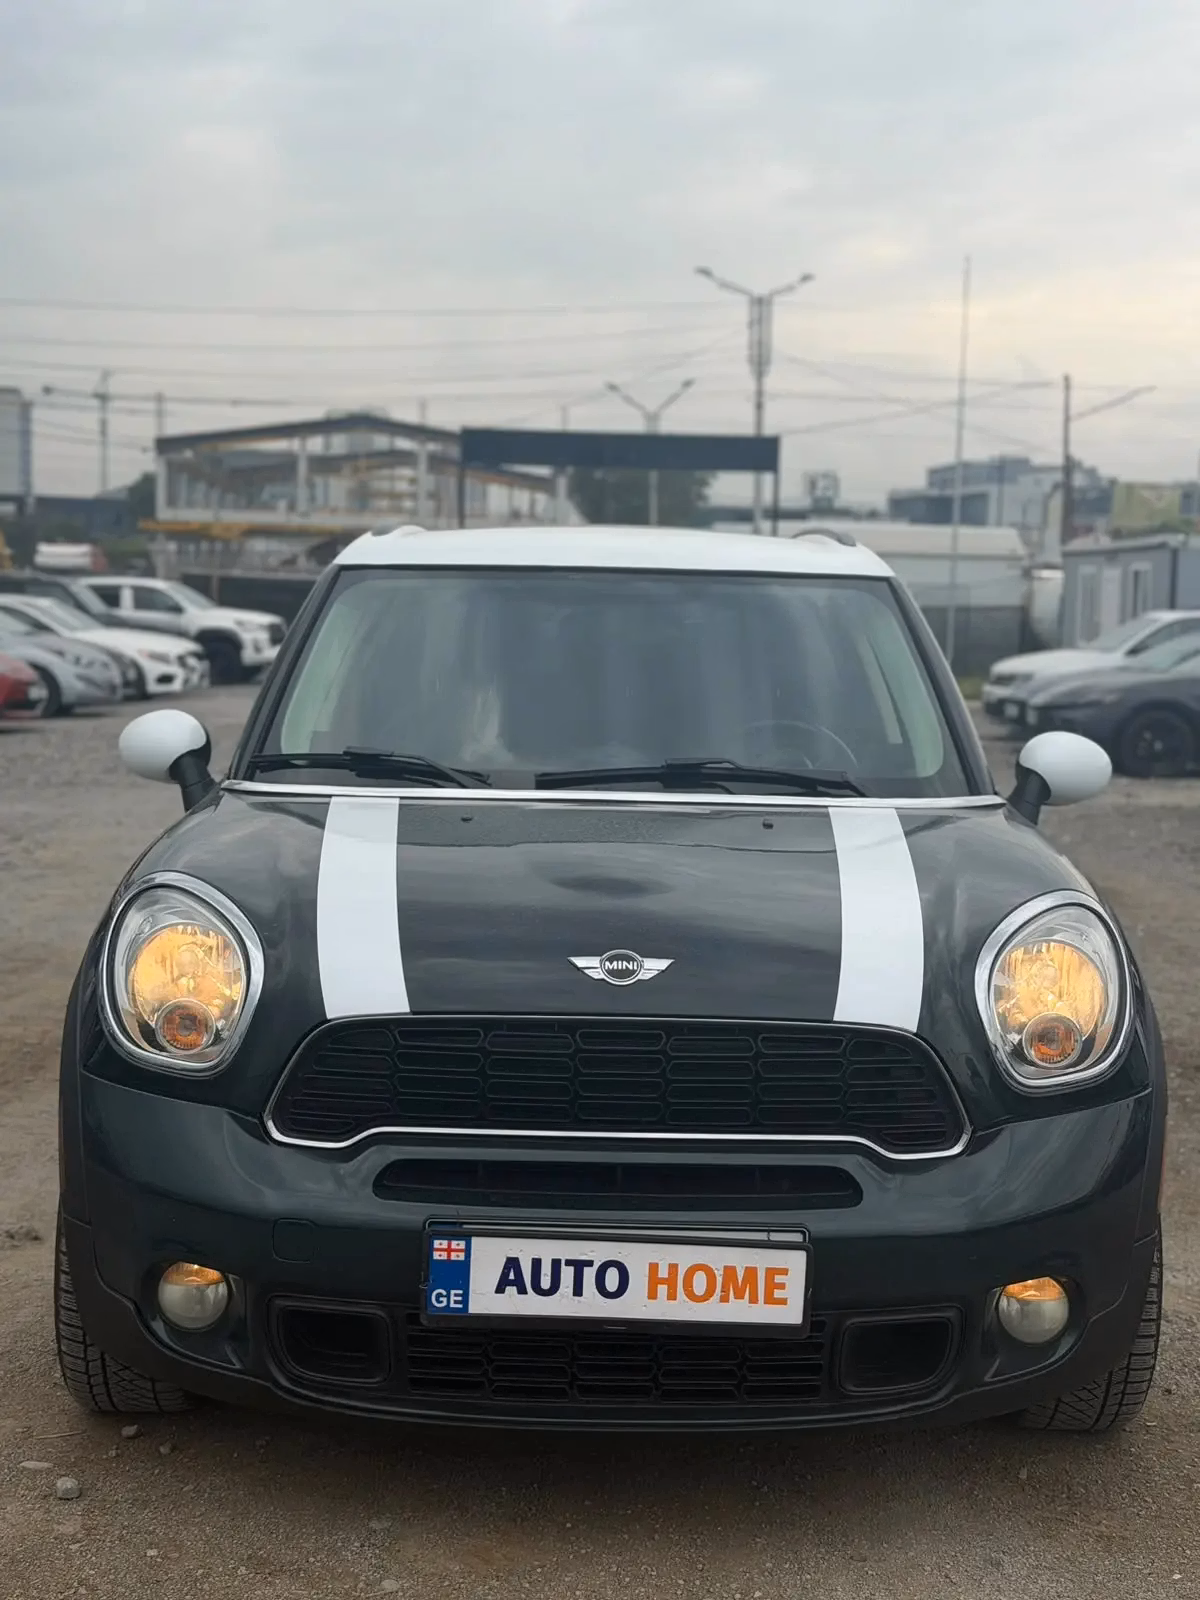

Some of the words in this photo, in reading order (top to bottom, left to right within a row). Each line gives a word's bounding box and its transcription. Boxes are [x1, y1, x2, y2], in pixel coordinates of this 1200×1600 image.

[605, 960, 637, 970] MINI
[494, 1256, 630, 1299] AUTO
[647, 1262, 790, 1306] HOME
[431, 1289, 464, 1309] GE
